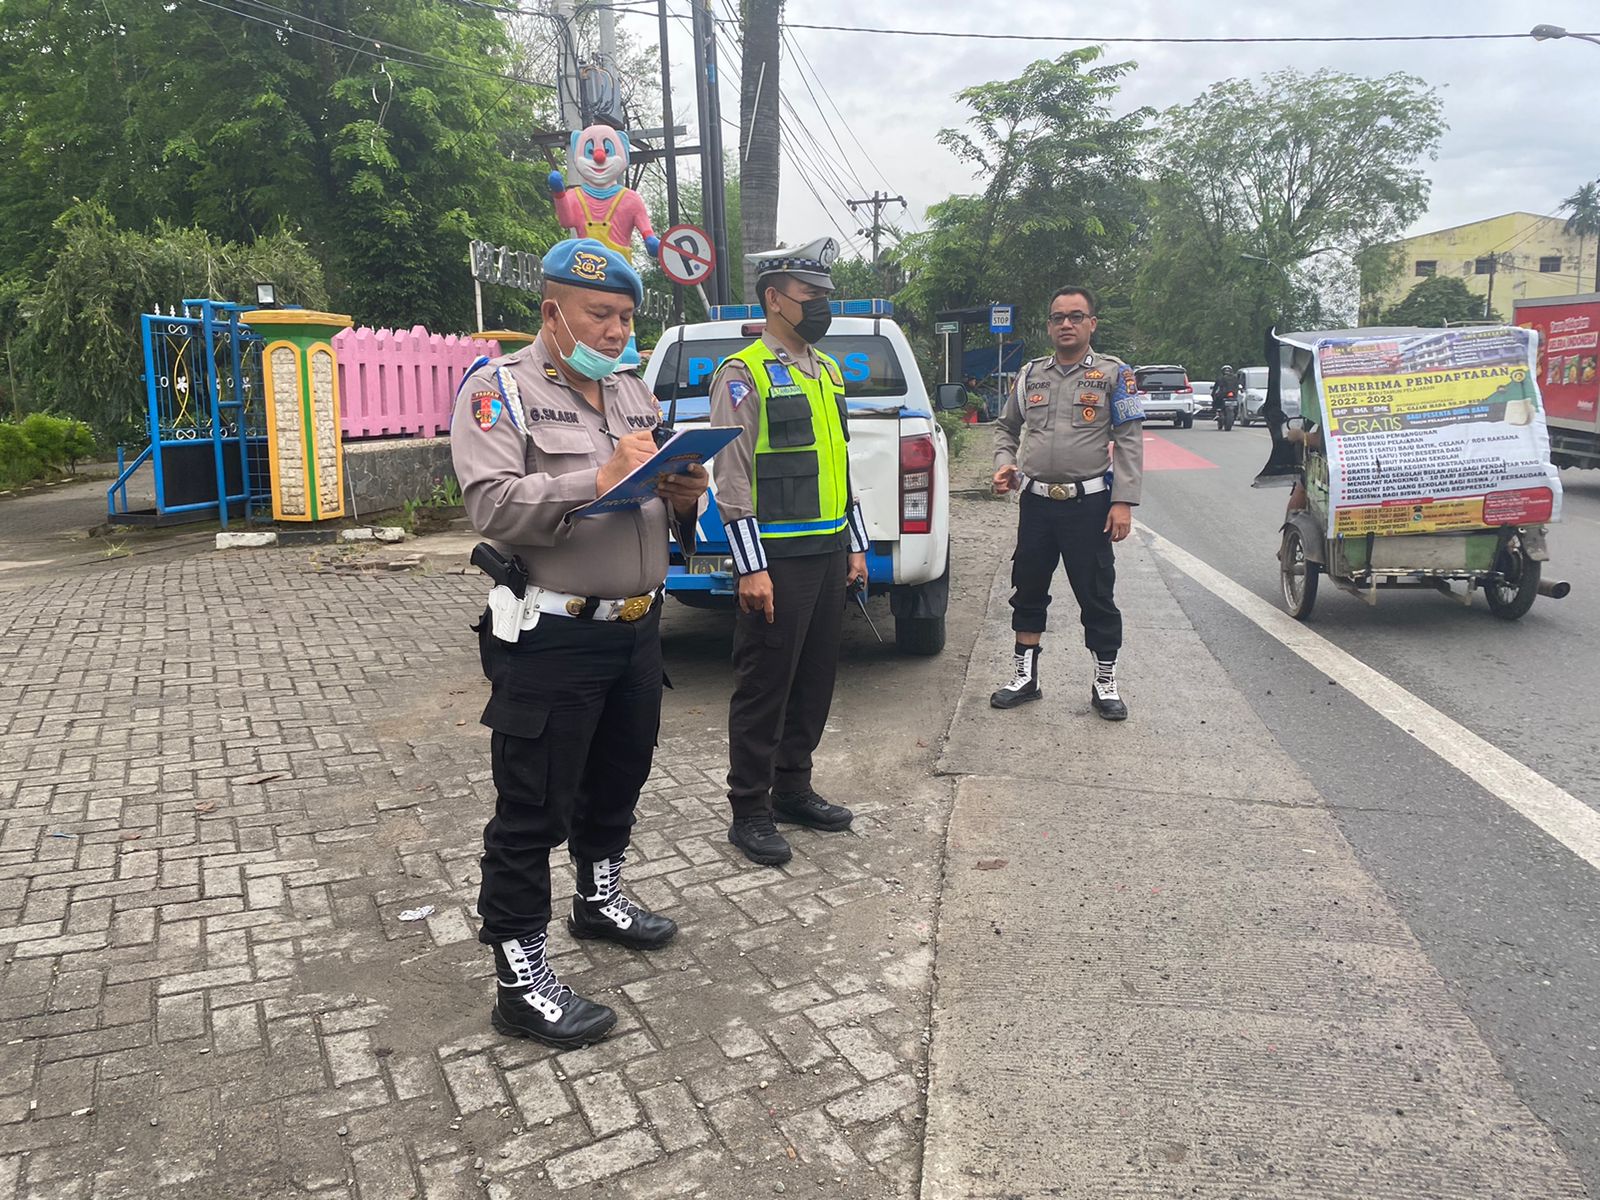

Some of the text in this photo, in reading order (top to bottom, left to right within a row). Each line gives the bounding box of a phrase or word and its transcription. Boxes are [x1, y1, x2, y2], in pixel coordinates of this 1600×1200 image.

[674, 235, 699, 276] P
[1077, 380, 1108, 390] POLRI
[1328, 368, 1510, 393] MENERIMA PENDAFTARAN
[1331, 398, 1358, 406] 2022
[1367, 395, 1394, 403] 2023
[530, 408, 579, 424] G.SILAEN
[1423, 410, 1451, 419] PESERTA
[1343, 417, 1402, 433] GRATIS
[1386, 430, 1437, 439] PEMBANGUNAN
[1487, 434, 1519, 442] RAKSANA
[1371, 458, 1399, 466] ARIBUT
[1501, 471, 1547, 480] BERSAUDARA
[1451, 483, 1498, 491] BERPRESTASI
